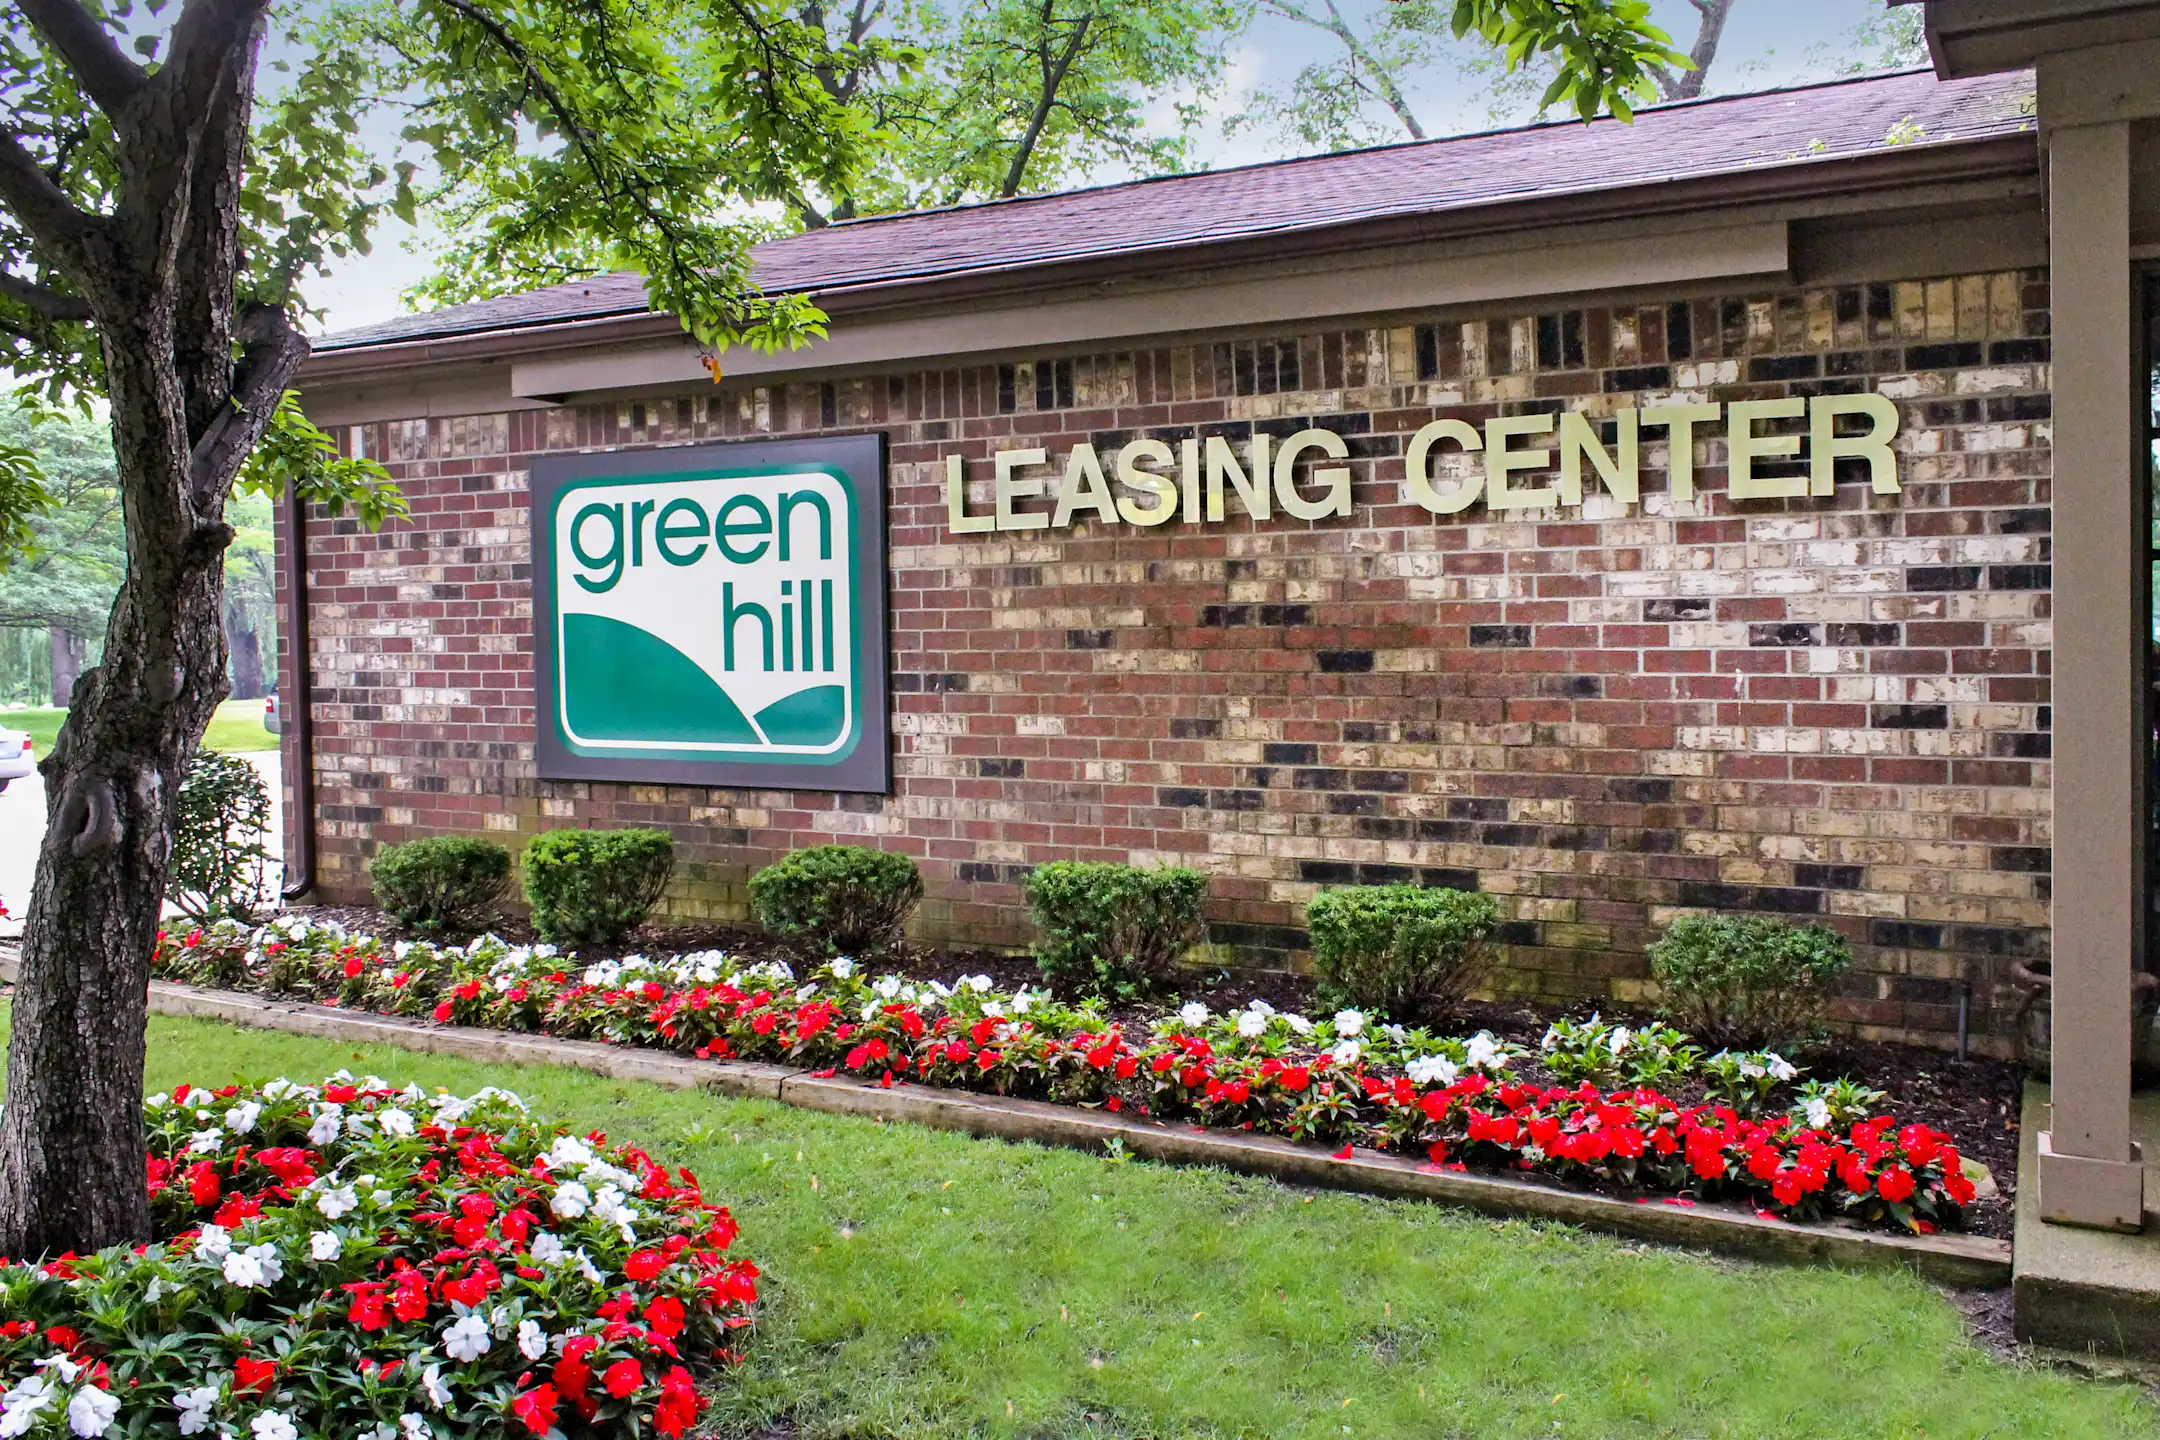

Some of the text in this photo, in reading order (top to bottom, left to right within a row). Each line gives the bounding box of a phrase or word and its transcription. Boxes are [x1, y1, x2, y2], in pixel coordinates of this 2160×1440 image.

[946, 392, 1902, 534] LEASING CENTER
[570, 489, 832, 594] green
[722, 579, 834, 672] hill
